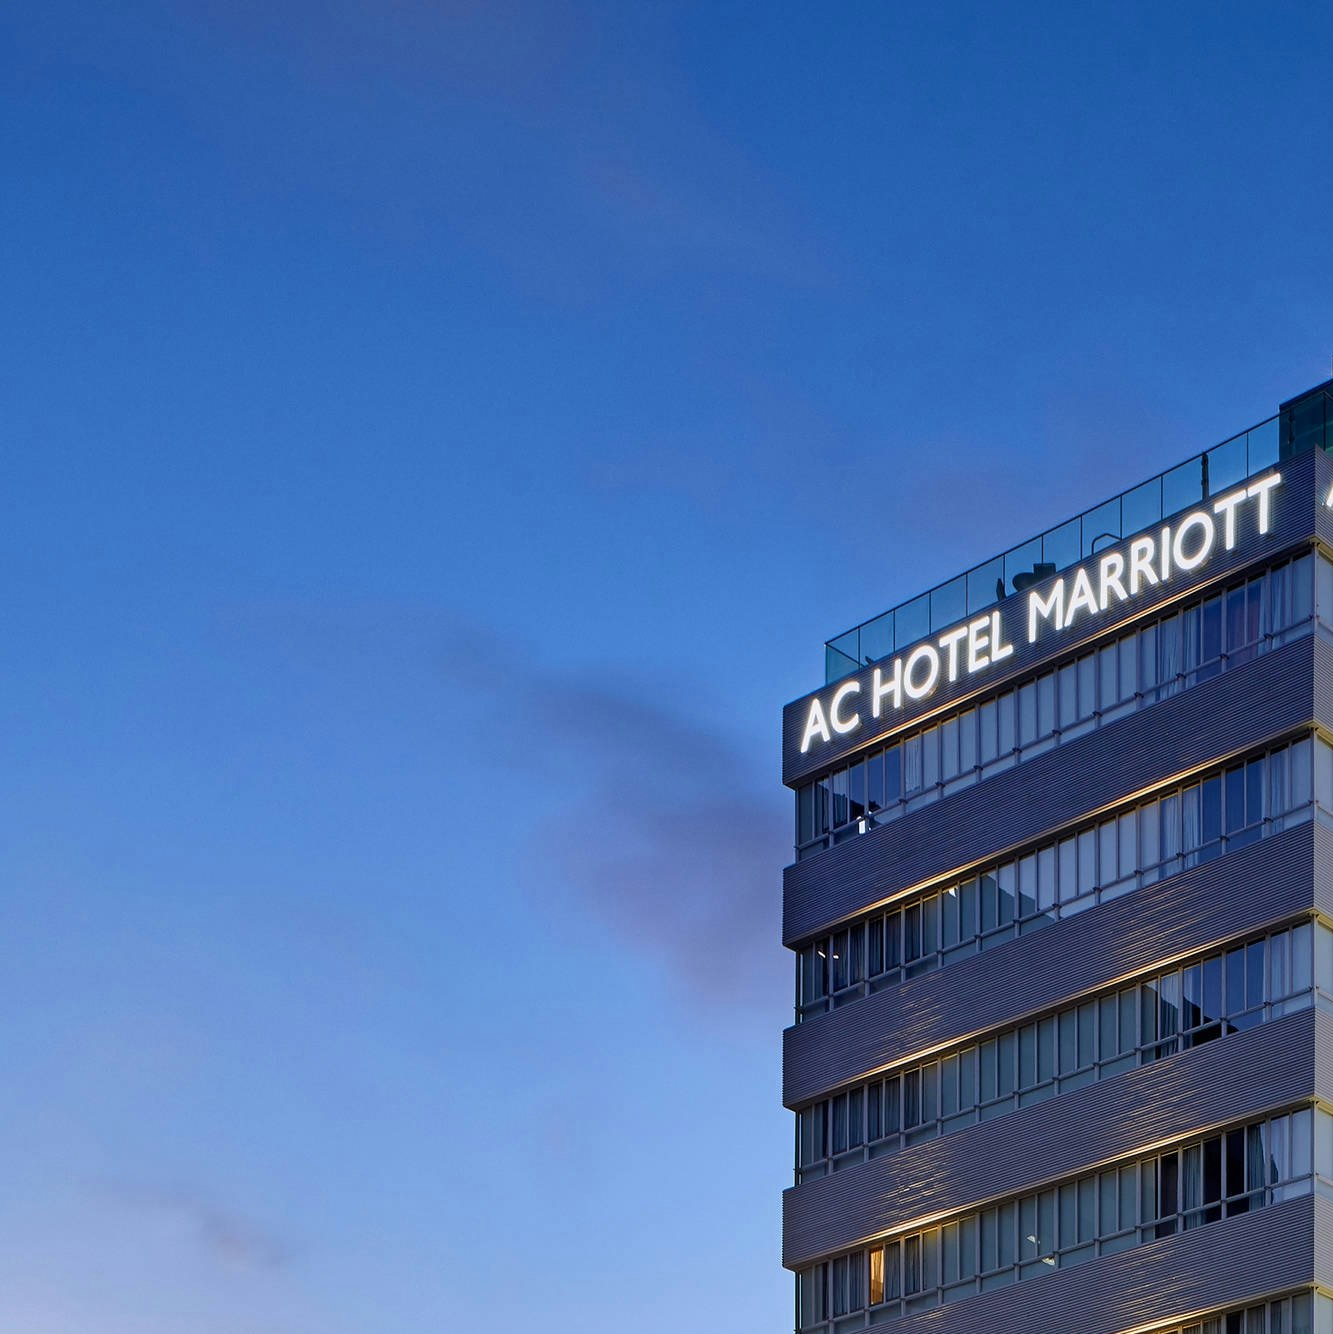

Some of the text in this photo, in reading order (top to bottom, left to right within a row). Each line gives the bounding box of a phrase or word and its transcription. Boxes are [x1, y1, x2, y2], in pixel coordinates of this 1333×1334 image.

[800, 472, 1283, 754] AC HOTEL MARRIOTT
